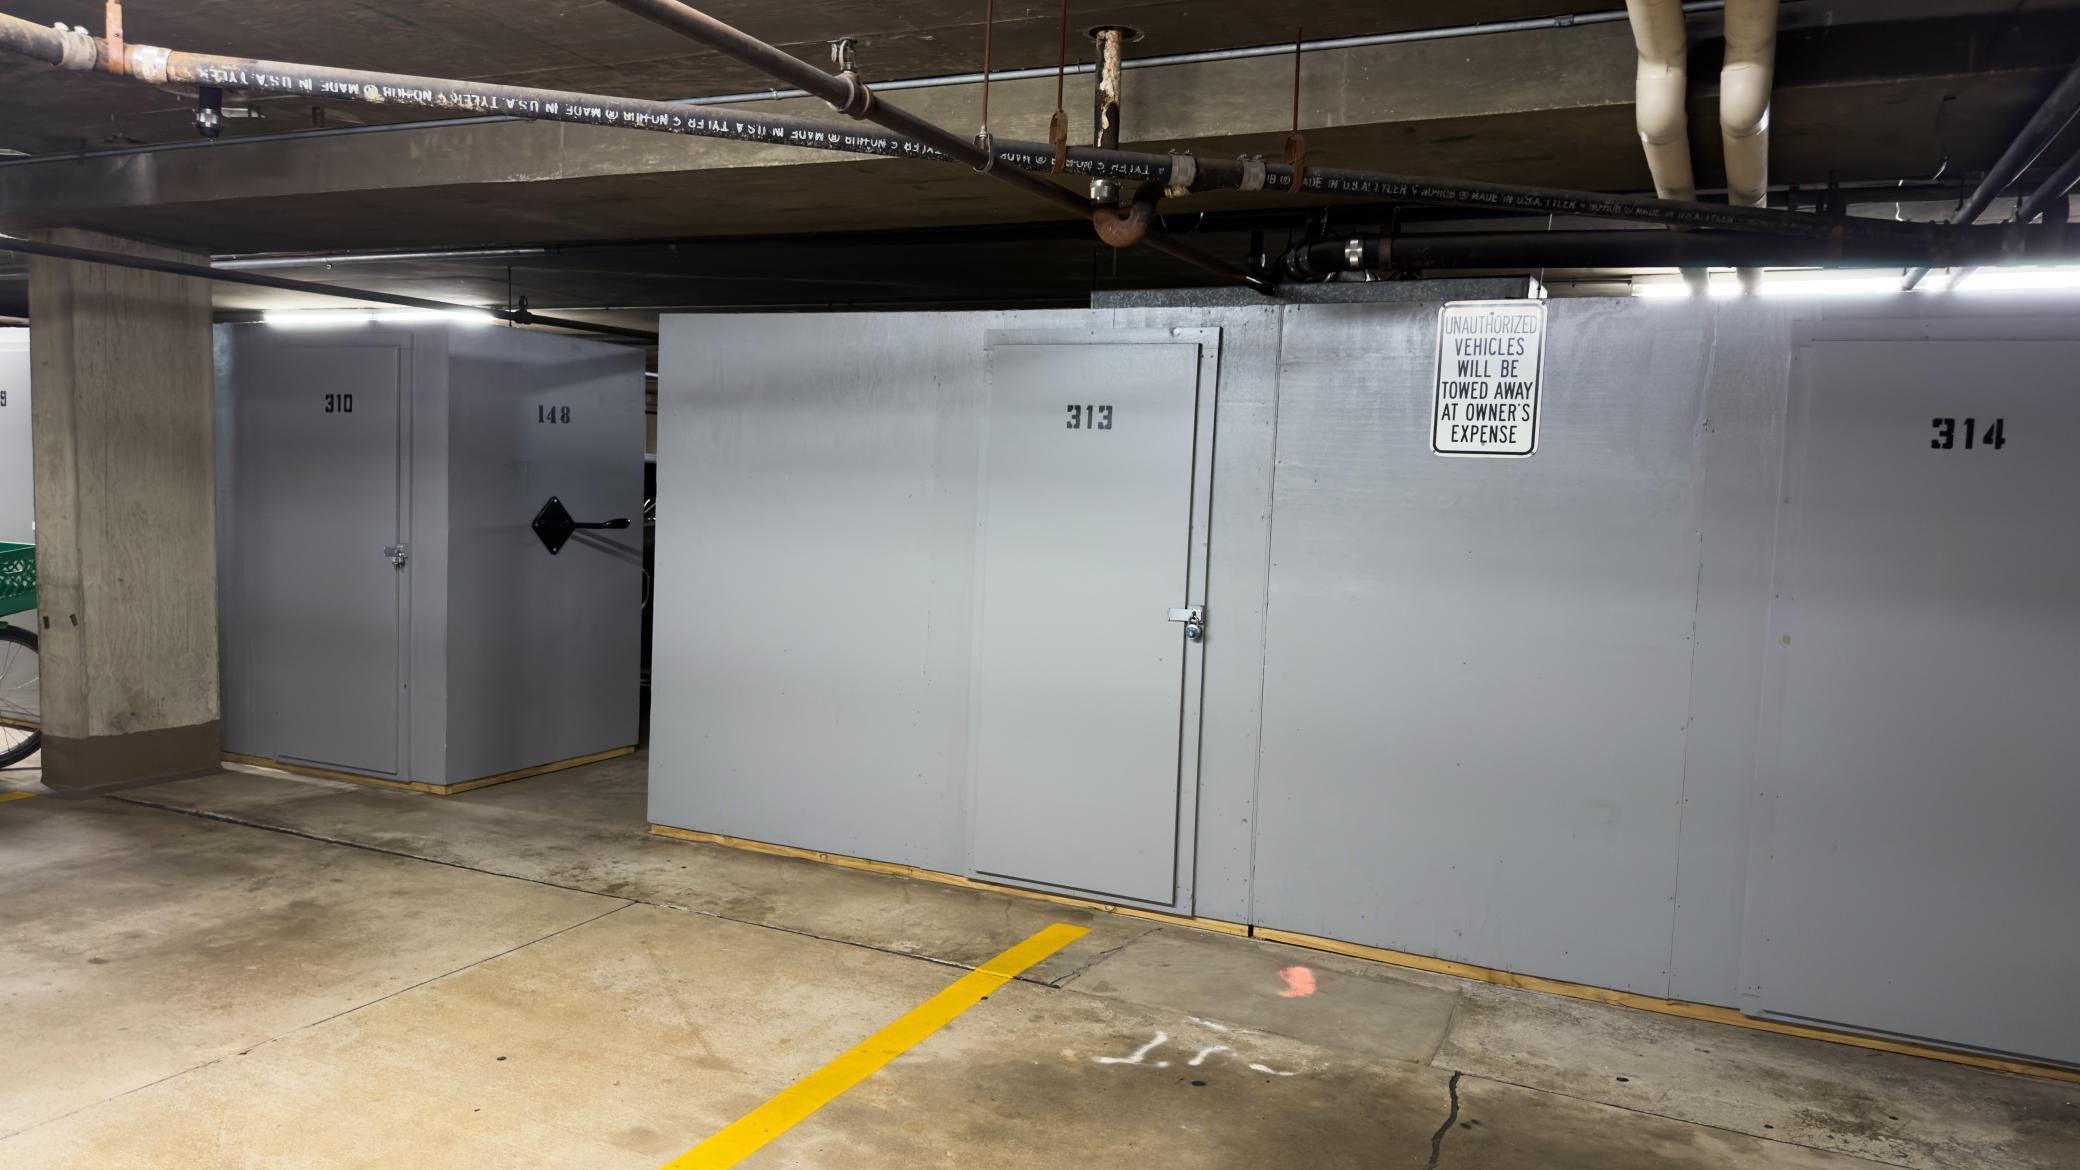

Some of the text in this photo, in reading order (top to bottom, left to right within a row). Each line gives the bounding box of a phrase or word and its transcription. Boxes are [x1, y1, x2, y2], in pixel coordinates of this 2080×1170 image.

[299, 78, 312, 91] IN
[321, 80, 359, 95] MADE
[545, 102, 559, 114] IN
[565, 105, 602, 118] MADE
[772, 127, 784, 137] IN
[790, 129, 824, 142] MADE
[1445, 315, 1538, 335] UNAUTHORIZED
[1455, 337, 1525, 356] VEHICLES
[1457, 359, 1519, 378] WILL BE
[1442, 381, 1533, 400] TOWED AWAY
[325, 393, 352, 413] 310
[1441, 403, 1530, 422] AT OWNER'S
[537, 405, 571, 424] 148
[1066, 404, 1113, 430] 313
[1451, 424, 1517, 444] EXPENSE
[1931, 418, 2006, 450] 314
